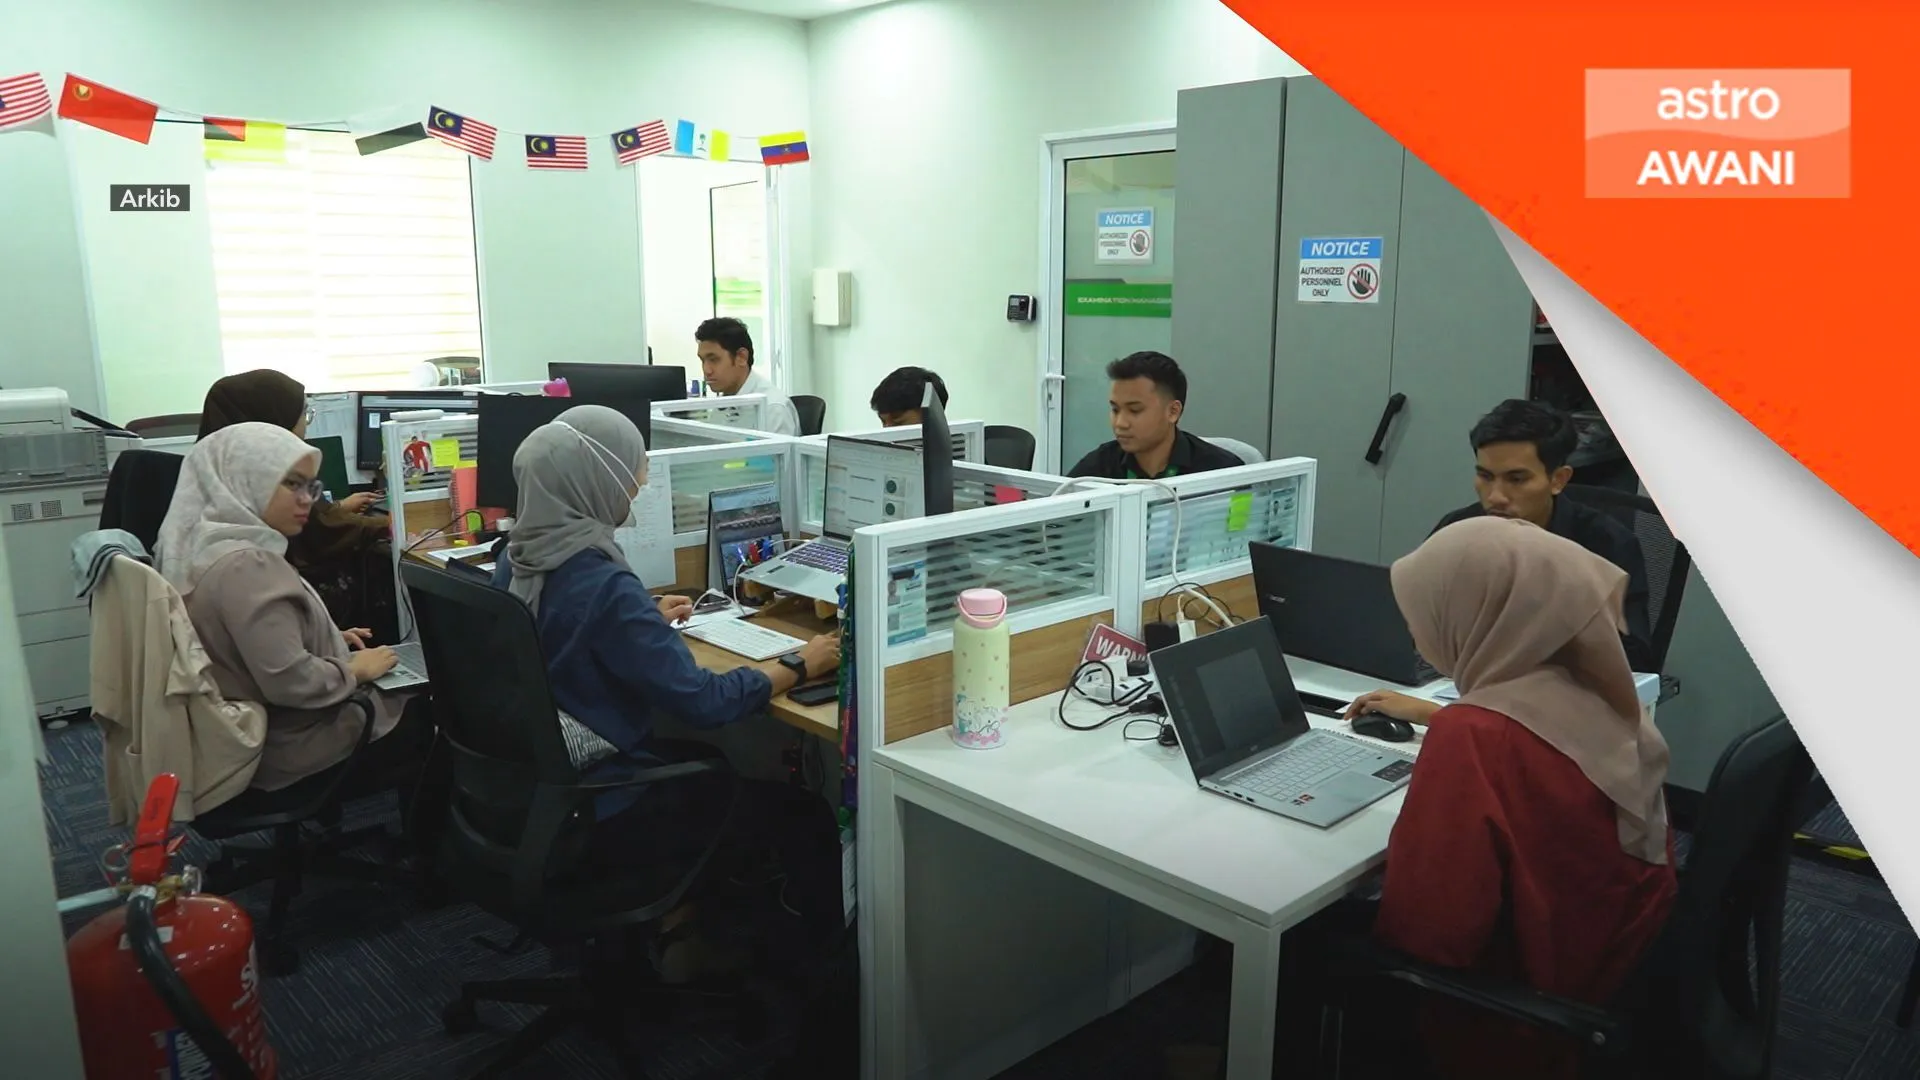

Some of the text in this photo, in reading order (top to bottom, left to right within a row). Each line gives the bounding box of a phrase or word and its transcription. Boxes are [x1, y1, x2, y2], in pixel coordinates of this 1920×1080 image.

[1105, 213, 1145, 225] NOTICE
[1310, 241, 1371, 256] NOTICE
[1300, 266, 1345, 276] AUTHORIZED
[1301, 277, 1343, 287] PERSONNEL
[1312, 288, 1330, 297] ONLY
